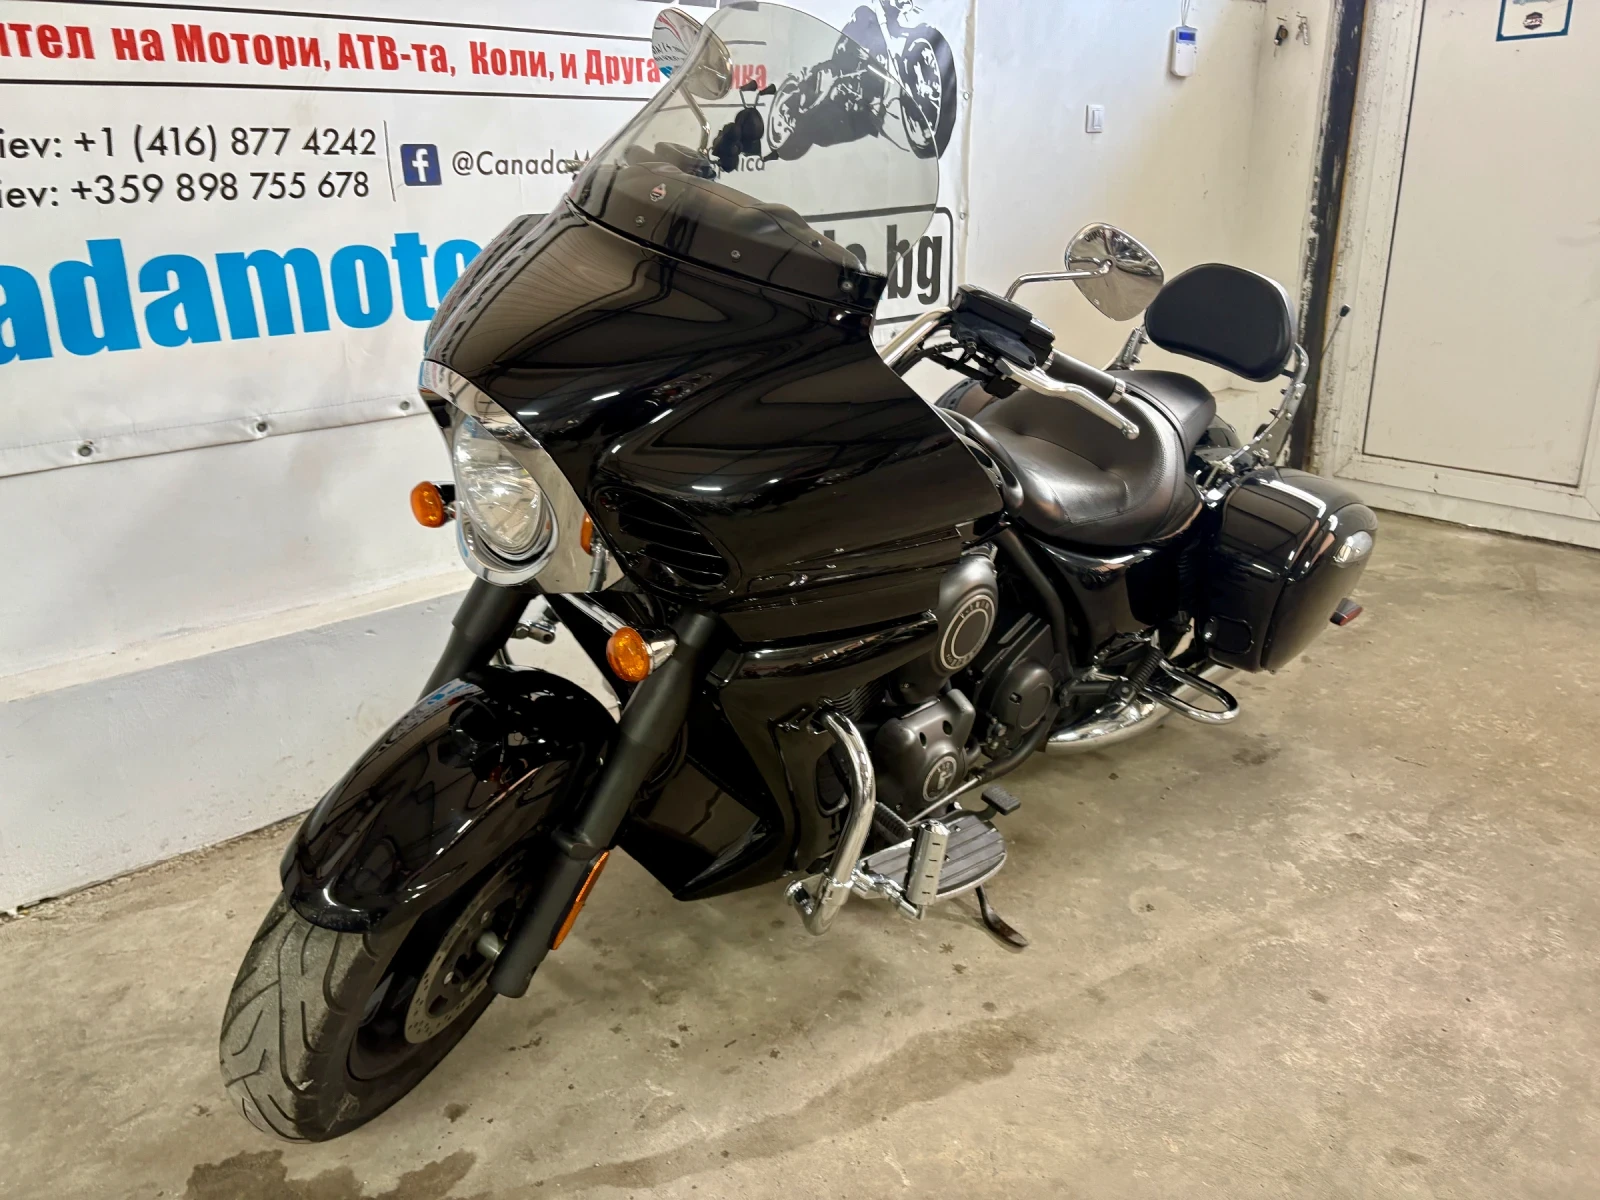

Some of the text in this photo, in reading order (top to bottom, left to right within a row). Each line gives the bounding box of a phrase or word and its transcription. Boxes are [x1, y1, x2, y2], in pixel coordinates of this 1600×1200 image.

[111, 27, 165, 62] на
[171, 23, 331, 71] Мотори,
[338, 32, 456, 77] АТВ-та,
[469, 40, 555, 81] Коли,
[560, 53, 578, 80] и
[584, 49, 661, 84] Друга
[74, 127, 114, 157] +1
[133, 124, 217, 163] (416)
[231, 127, 291, 156] 877
[302, 127, 376, 156] 4242
[452, 149, 592, 176] @Canada
[70, 173, 164, 205] +359
[176, 172, 238, 202] 898
[249, 171, 306, 200] 755
[317, 171, 369, 199] 678
